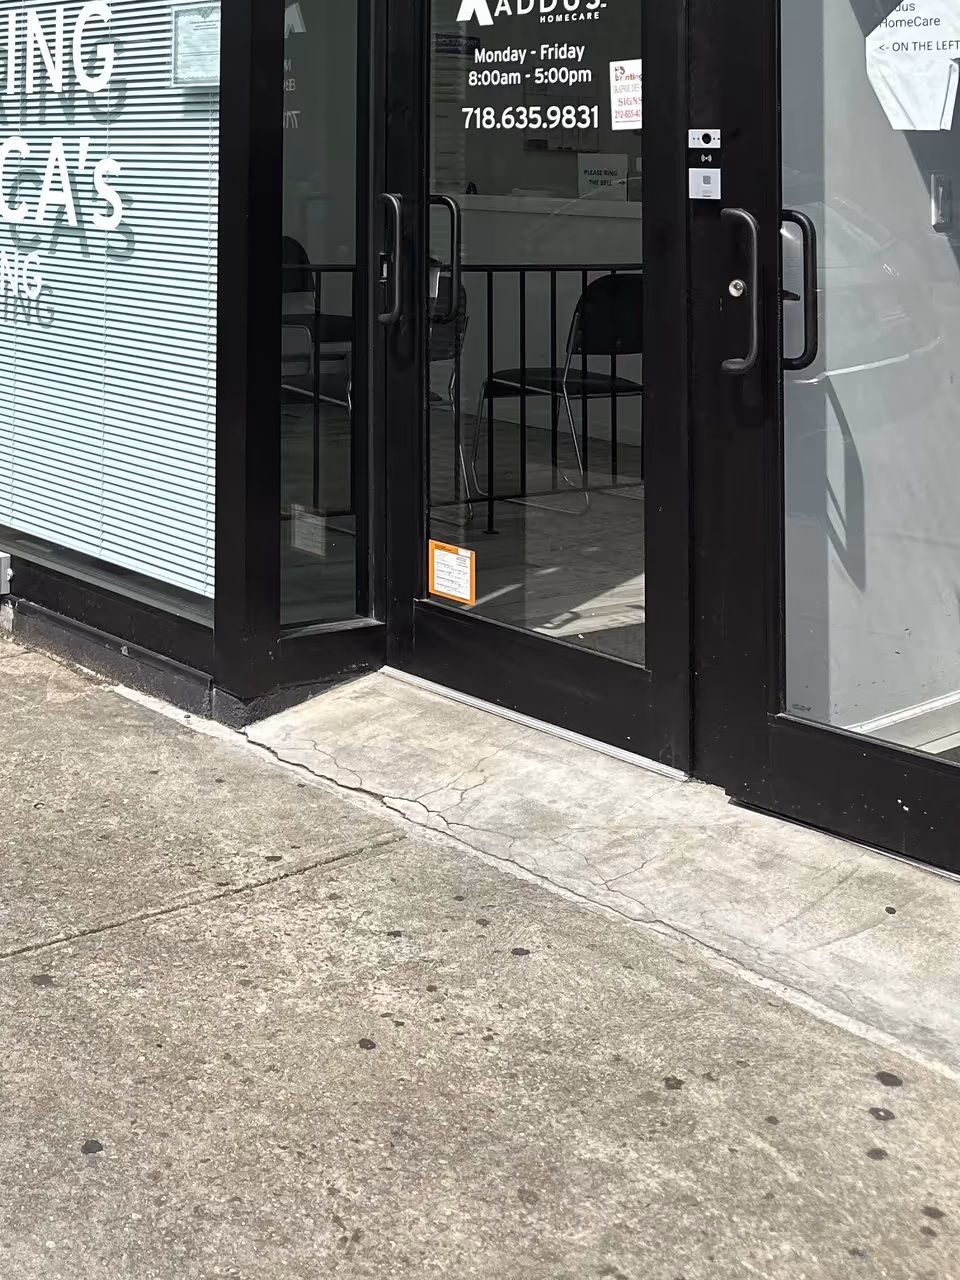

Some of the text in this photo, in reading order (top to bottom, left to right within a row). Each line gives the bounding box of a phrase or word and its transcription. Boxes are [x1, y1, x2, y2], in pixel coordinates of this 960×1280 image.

[540, 11, 600, 23] HOMECARE
[474, 46, 527, 64] Monday
[540, 43, 585, 62] Friday
[892, 41, 909, 52] ON
[912, 41, 933, 51] THE
[936, 40, 960, 51] LEFT
[468, 70, 521, 86] 8:00am
[534, 67, 592, 86] 5:00pm
[461, 105, 599, 129] 718.635.9831
